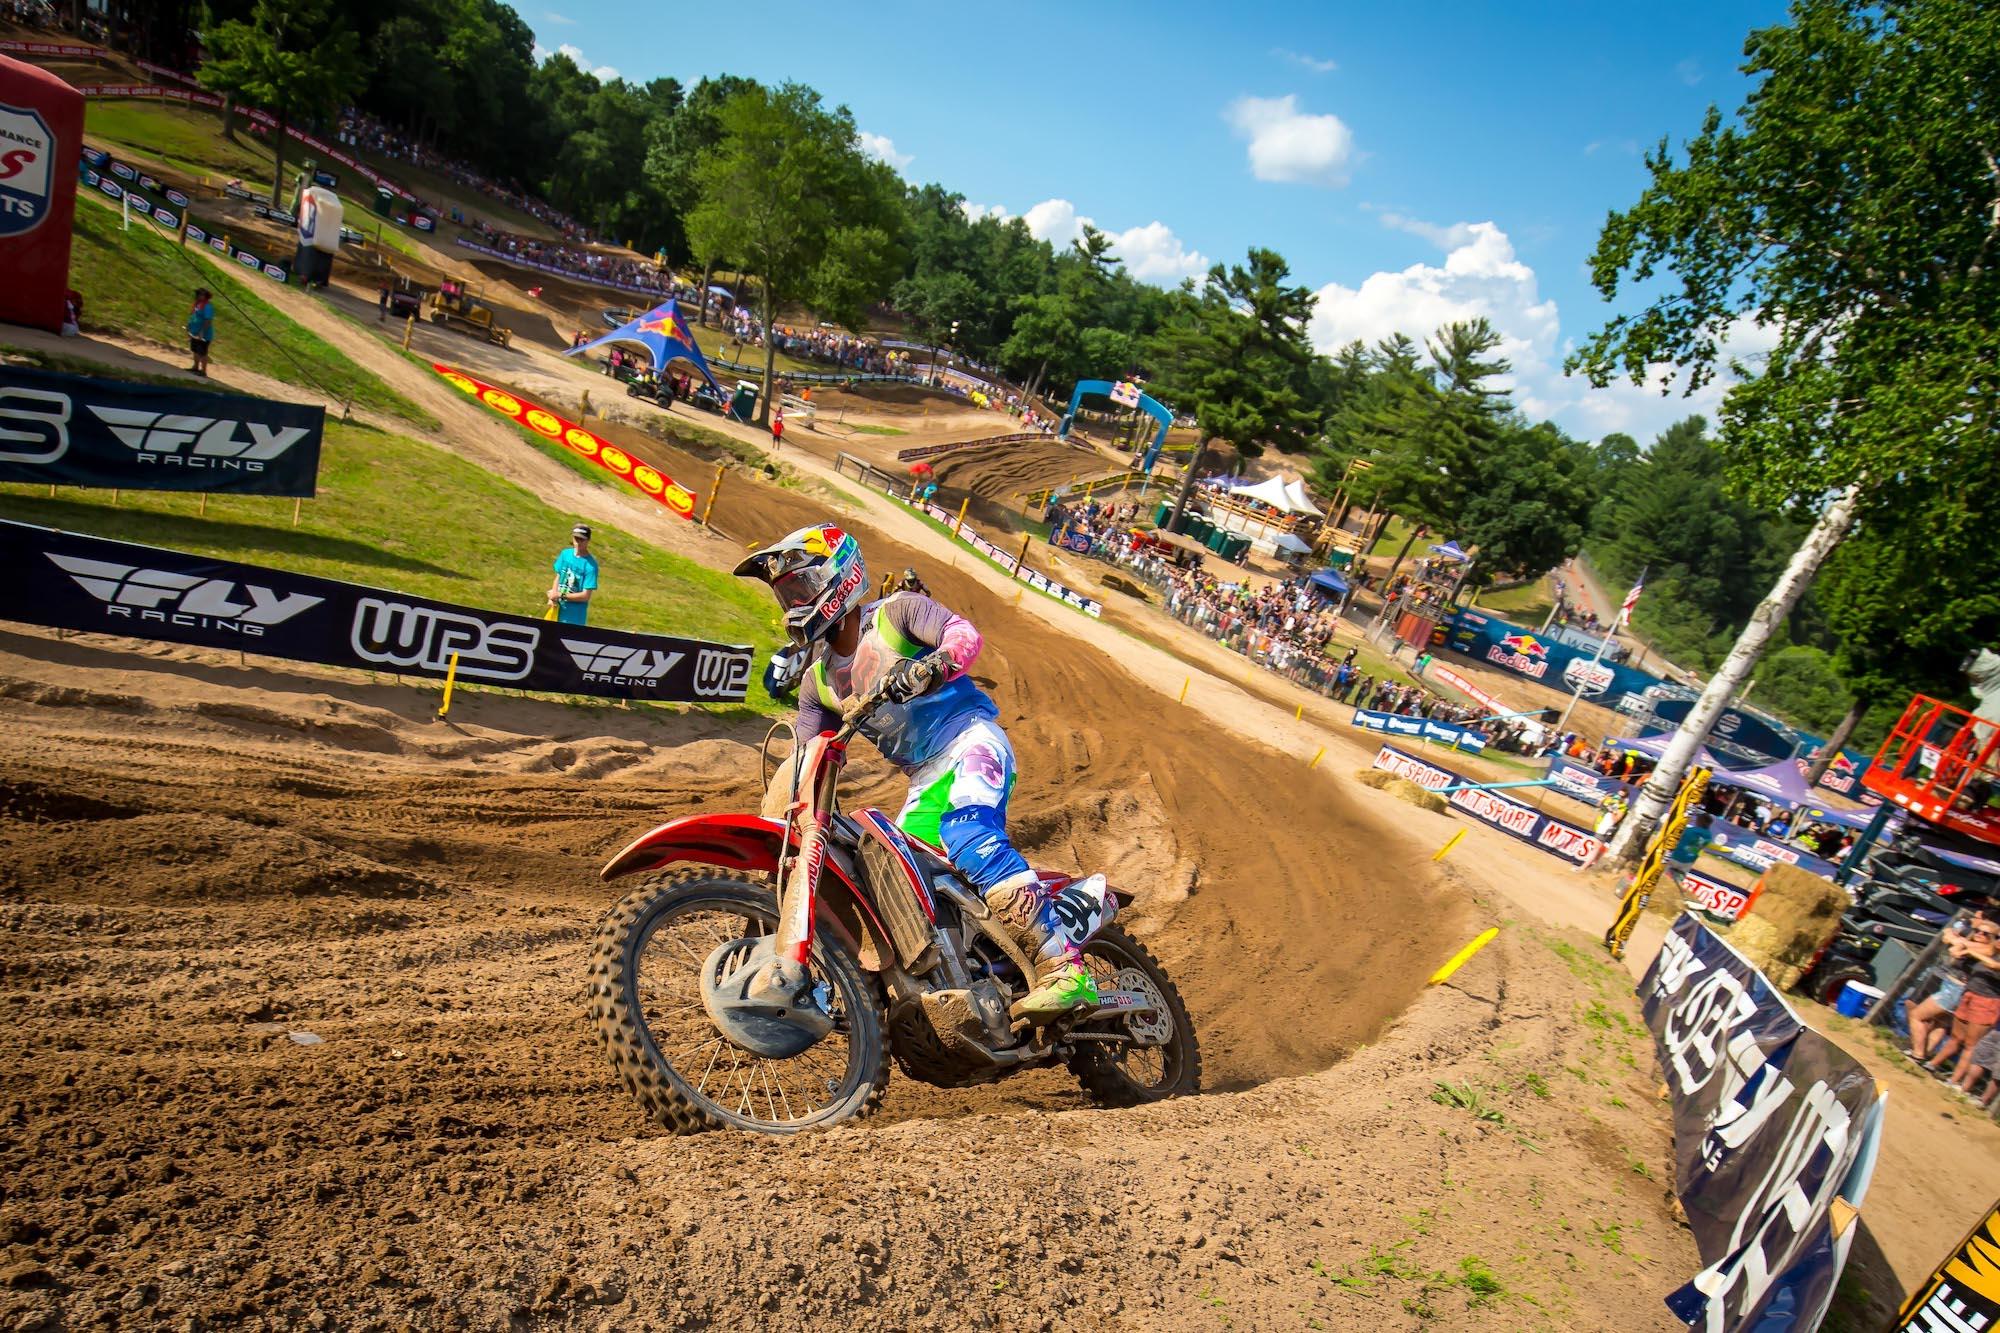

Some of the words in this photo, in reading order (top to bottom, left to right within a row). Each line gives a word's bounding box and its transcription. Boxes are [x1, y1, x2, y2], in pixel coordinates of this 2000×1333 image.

[86, 404, 311, 461] FLY
[137, 453, 264, 472] RACING
[42, 551, 326, 625] FLY
[107, 604, 264, 636] RACING
[350, 597, 541, 681] WPS
[560, 637, 687, 678] FLY
[582, 672, 658, 688] RACING
[950, 810, 979, 828] FOX
[807, 838, 826, 896] HOWA
[1053, 887, 1103, 941] 94
[1898, 1282, 1990, 1333] HE
